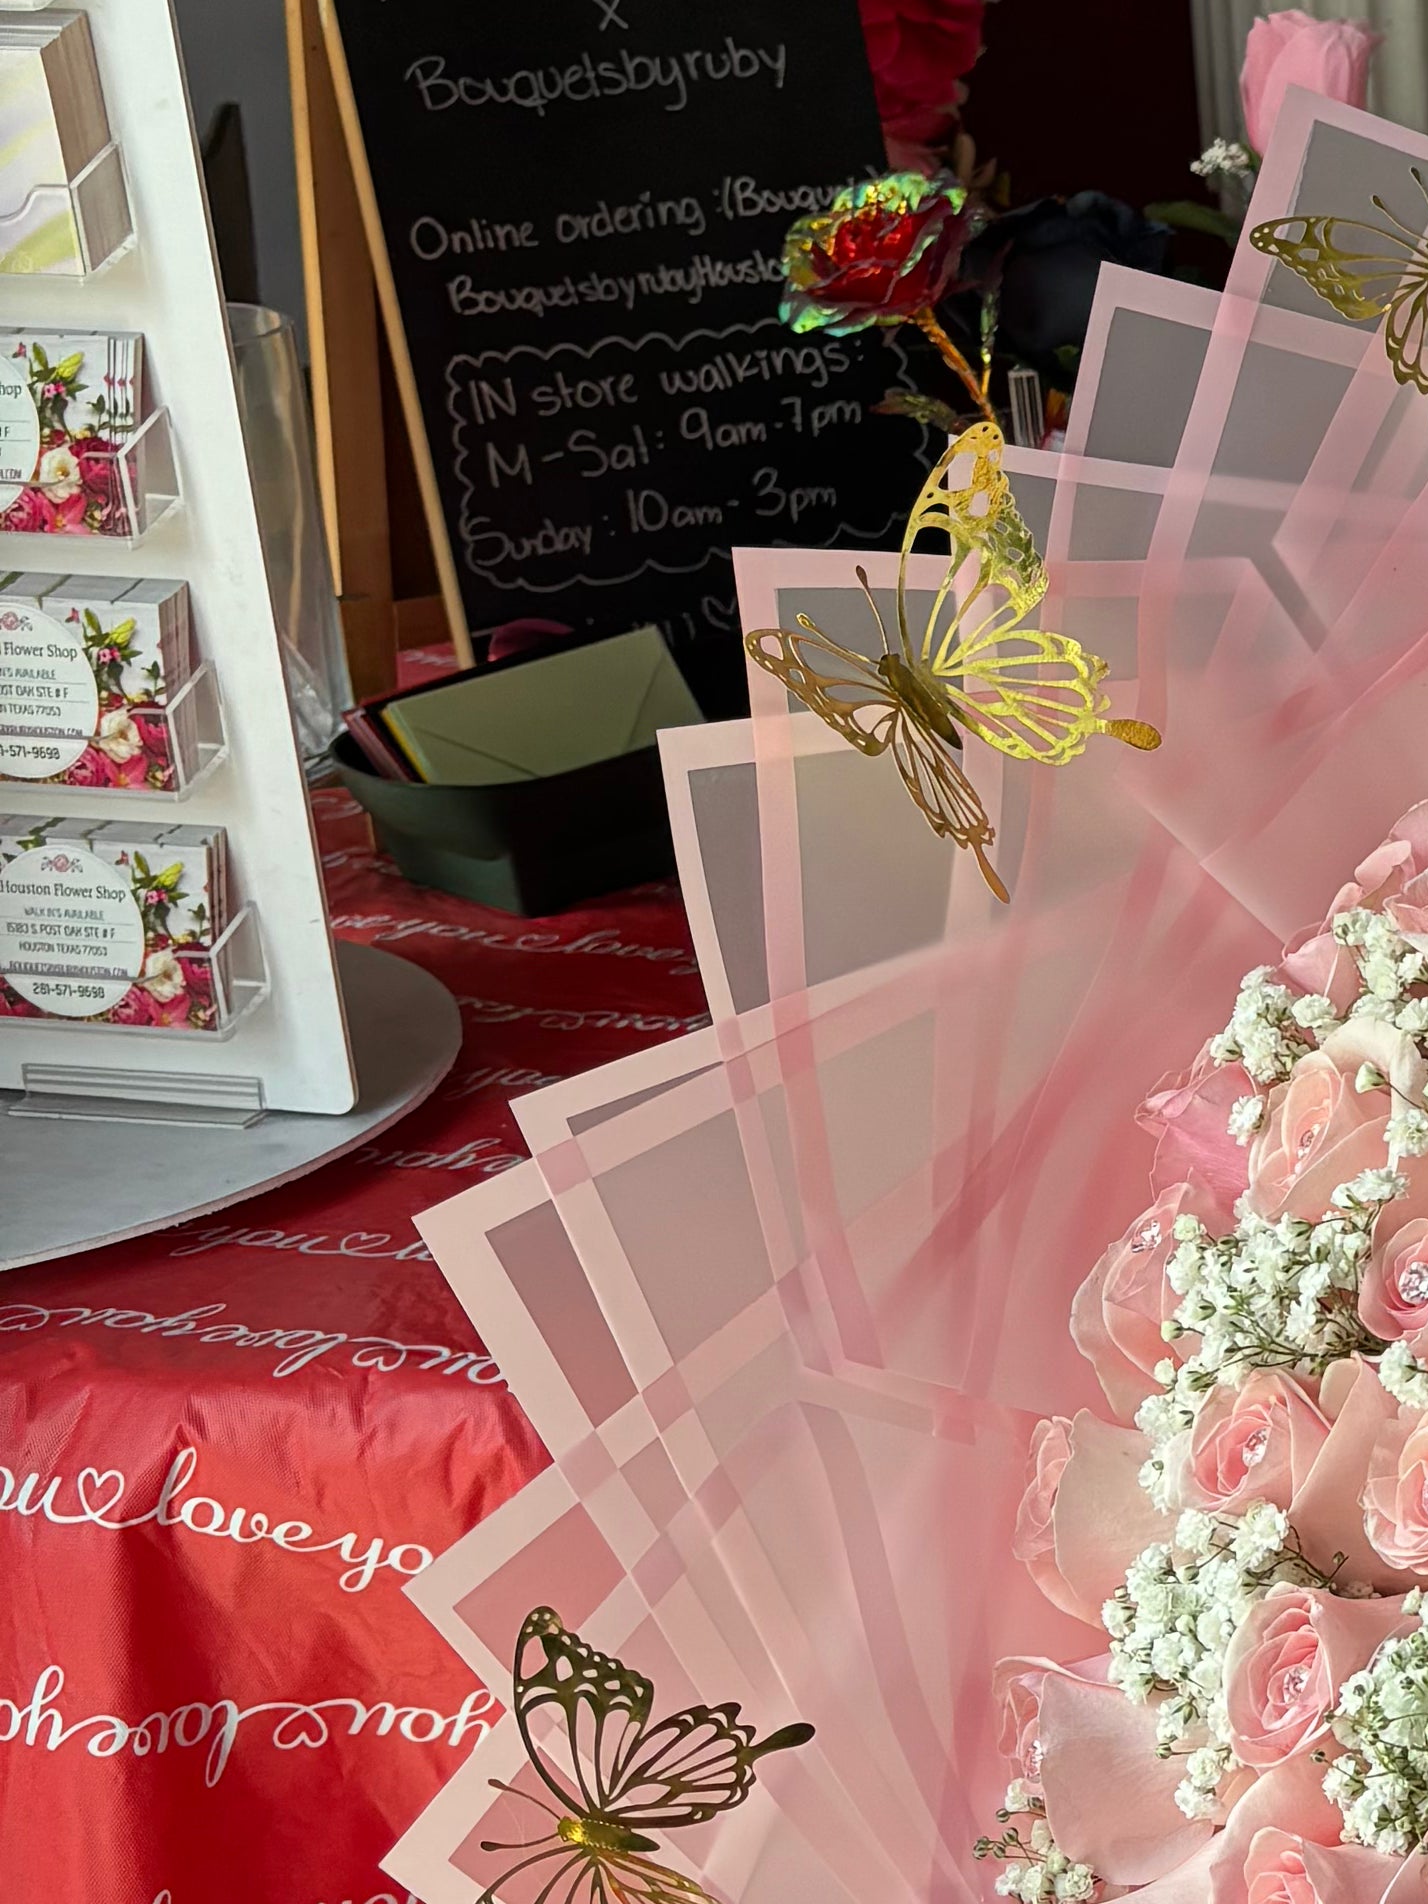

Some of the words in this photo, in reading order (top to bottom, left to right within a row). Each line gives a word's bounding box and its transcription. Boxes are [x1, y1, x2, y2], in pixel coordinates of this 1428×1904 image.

[410, 216, 540, 261] Online
[555, 191, 708, 244] ordering
[530, 371, 640, 417] store
[47, 644, 78, 662] Shop
[96, 886, 126, 903] Shop
[325, 1536, 434, 1592] yo
